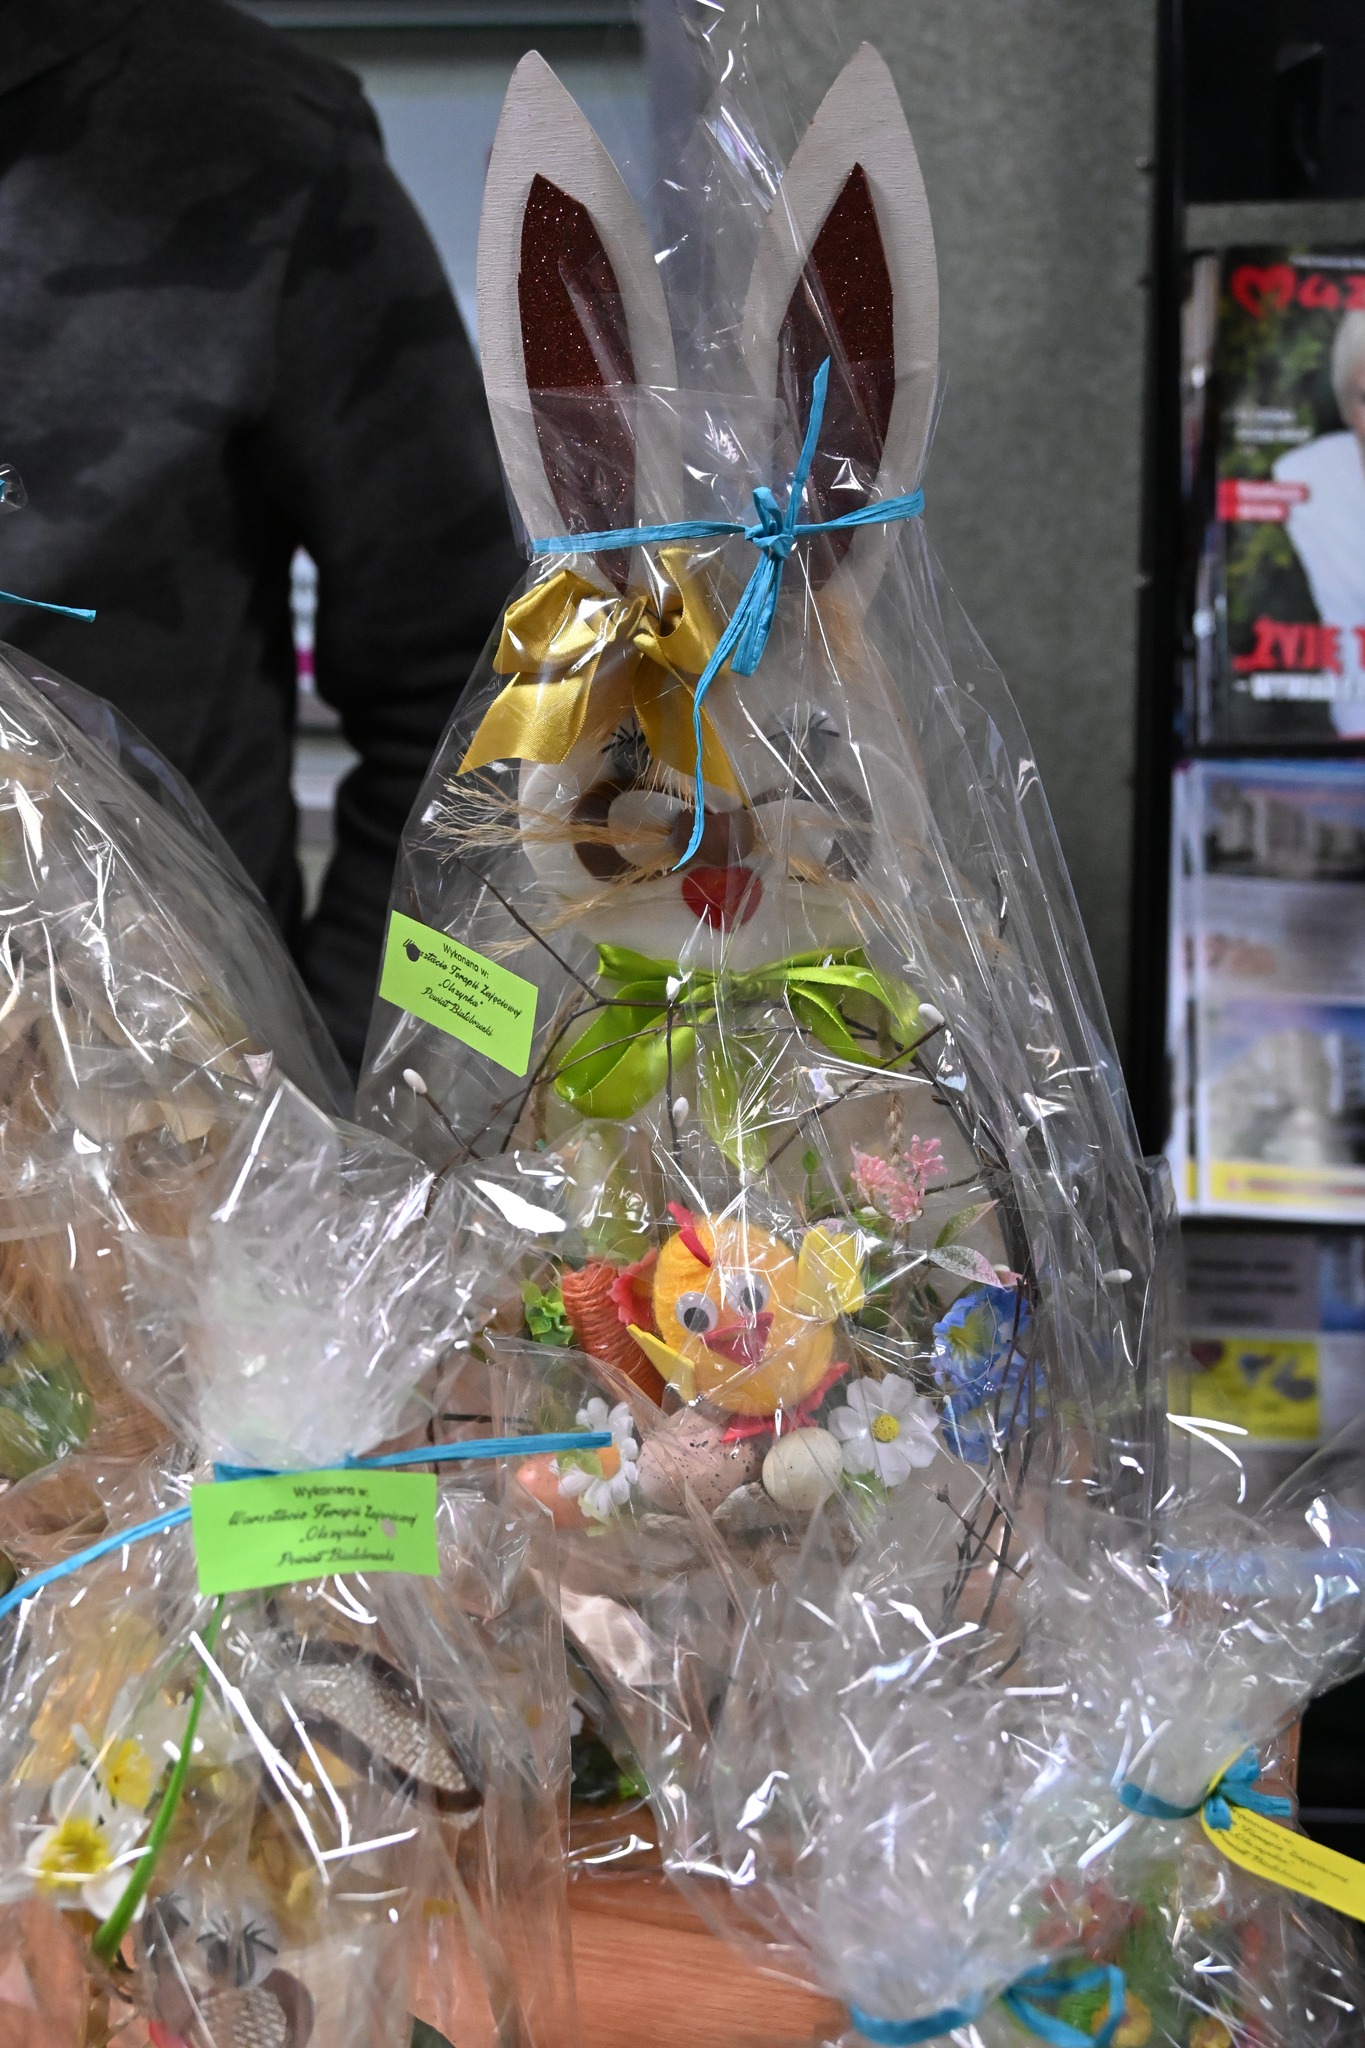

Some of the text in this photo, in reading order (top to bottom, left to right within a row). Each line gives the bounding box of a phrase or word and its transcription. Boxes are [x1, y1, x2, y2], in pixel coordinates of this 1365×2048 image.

[443, 943, 479, 972] Wykonano
[421, 986, 493, 1037] Powiat Białobrzeski
[449, 965, 479, 990] Terapii
[480, 984, 523, 1020] Zajęciowej
[292, 1485, 355, 1500] Wykonano
